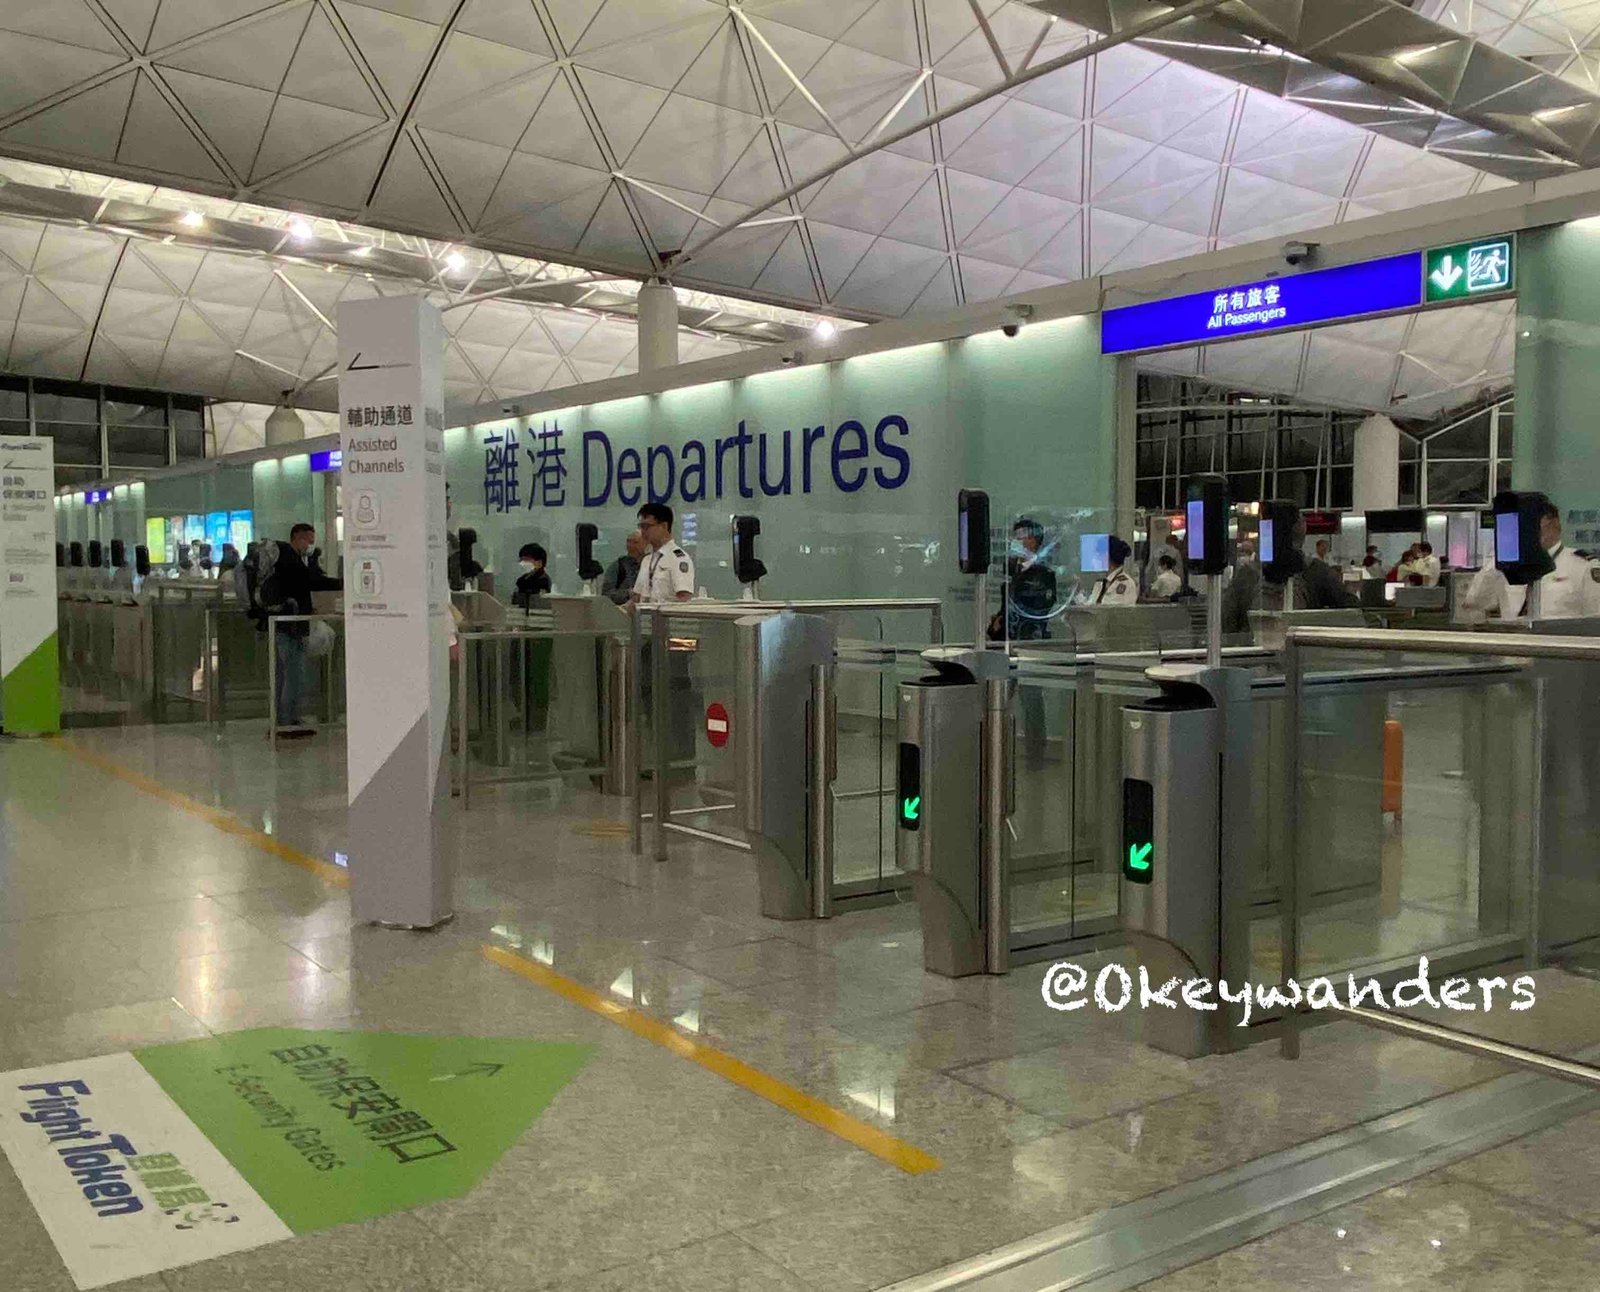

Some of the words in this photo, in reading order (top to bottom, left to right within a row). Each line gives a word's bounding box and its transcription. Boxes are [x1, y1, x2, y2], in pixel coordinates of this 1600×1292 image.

[1207, 315, 1222, 329] All
[1224, 307, 1286, 326] Passengers
[1213, 284, 1280, 314] 所有旅客
[346, 403, 414, 428] 輔助通道
[348, 436, 398, 452] Assisted
[348, 457, 405, 473] Channels
[483, 418, 567, 515] 離港
[582, 414, 911, 508] Departures
[18, 1079, 101, 1142] Flight
[270, 1044, 457, 1163] 自助保安閘口
[284, 1127, 345, 1172] Gates
[57, 1134, 144, 1217] Token
